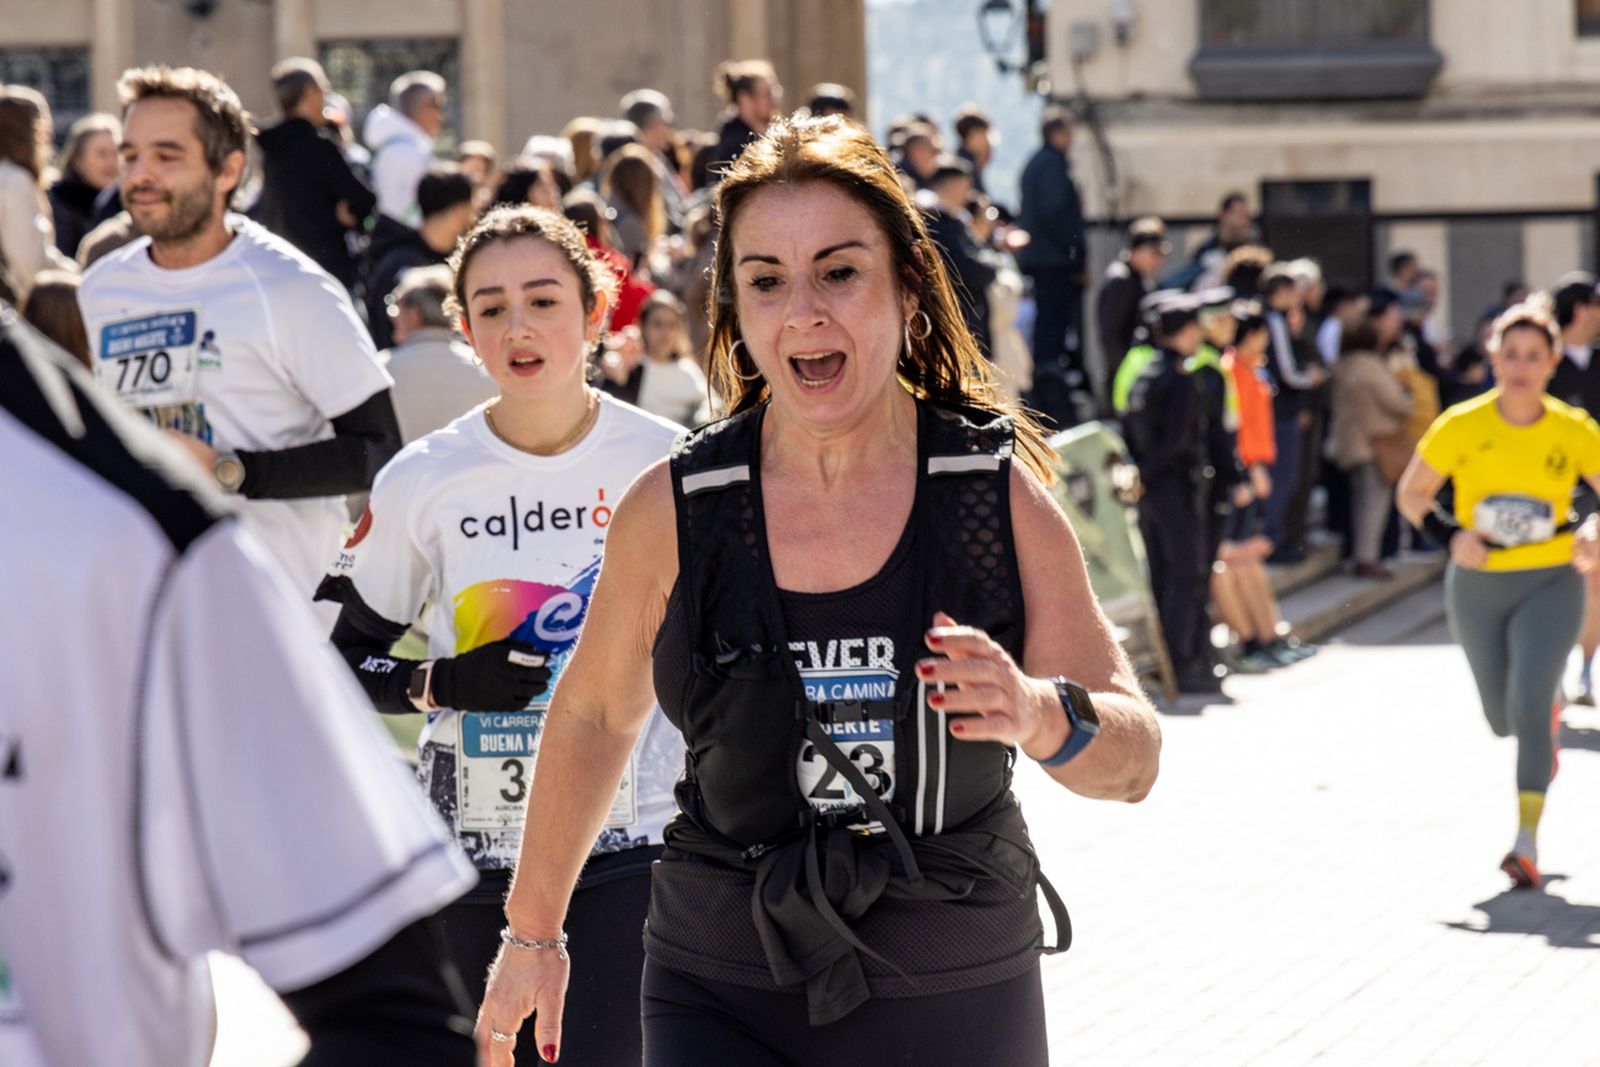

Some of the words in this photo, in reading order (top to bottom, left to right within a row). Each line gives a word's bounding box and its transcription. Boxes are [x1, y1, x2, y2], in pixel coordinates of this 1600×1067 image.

[116, 351, 171, 391] 770
[480, 716, 491, 728] VI
[480, 734, 524, 752] BUENA
[500, 758, 526, 803] 3
[802, 743, 892, 799] 23
